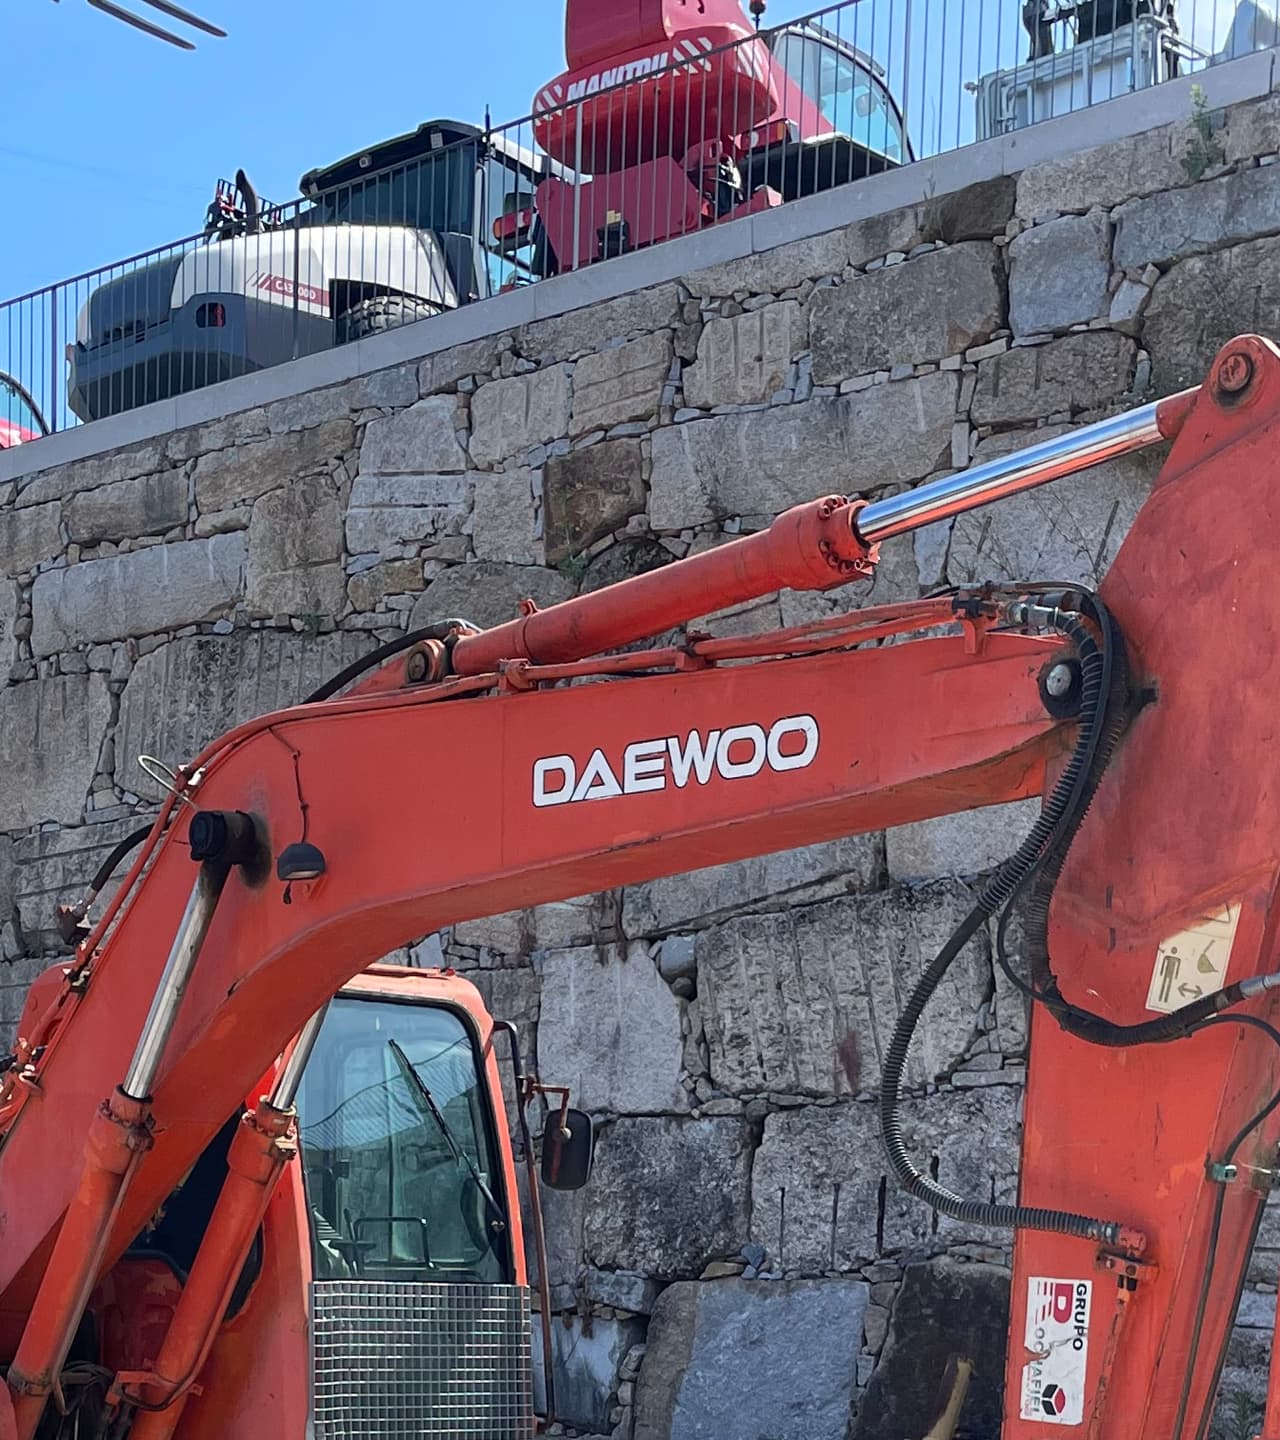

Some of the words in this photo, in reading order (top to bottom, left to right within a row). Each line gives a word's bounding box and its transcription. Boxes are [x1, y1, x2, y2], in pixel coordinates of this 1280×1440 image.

[566, 51, 670, 109] MANITOU
[275, 280, 317, 300] CA300D
[531, 713, 820, 808] DAEWOO
[1072, 1282, 1088, 1352] GRUPO
